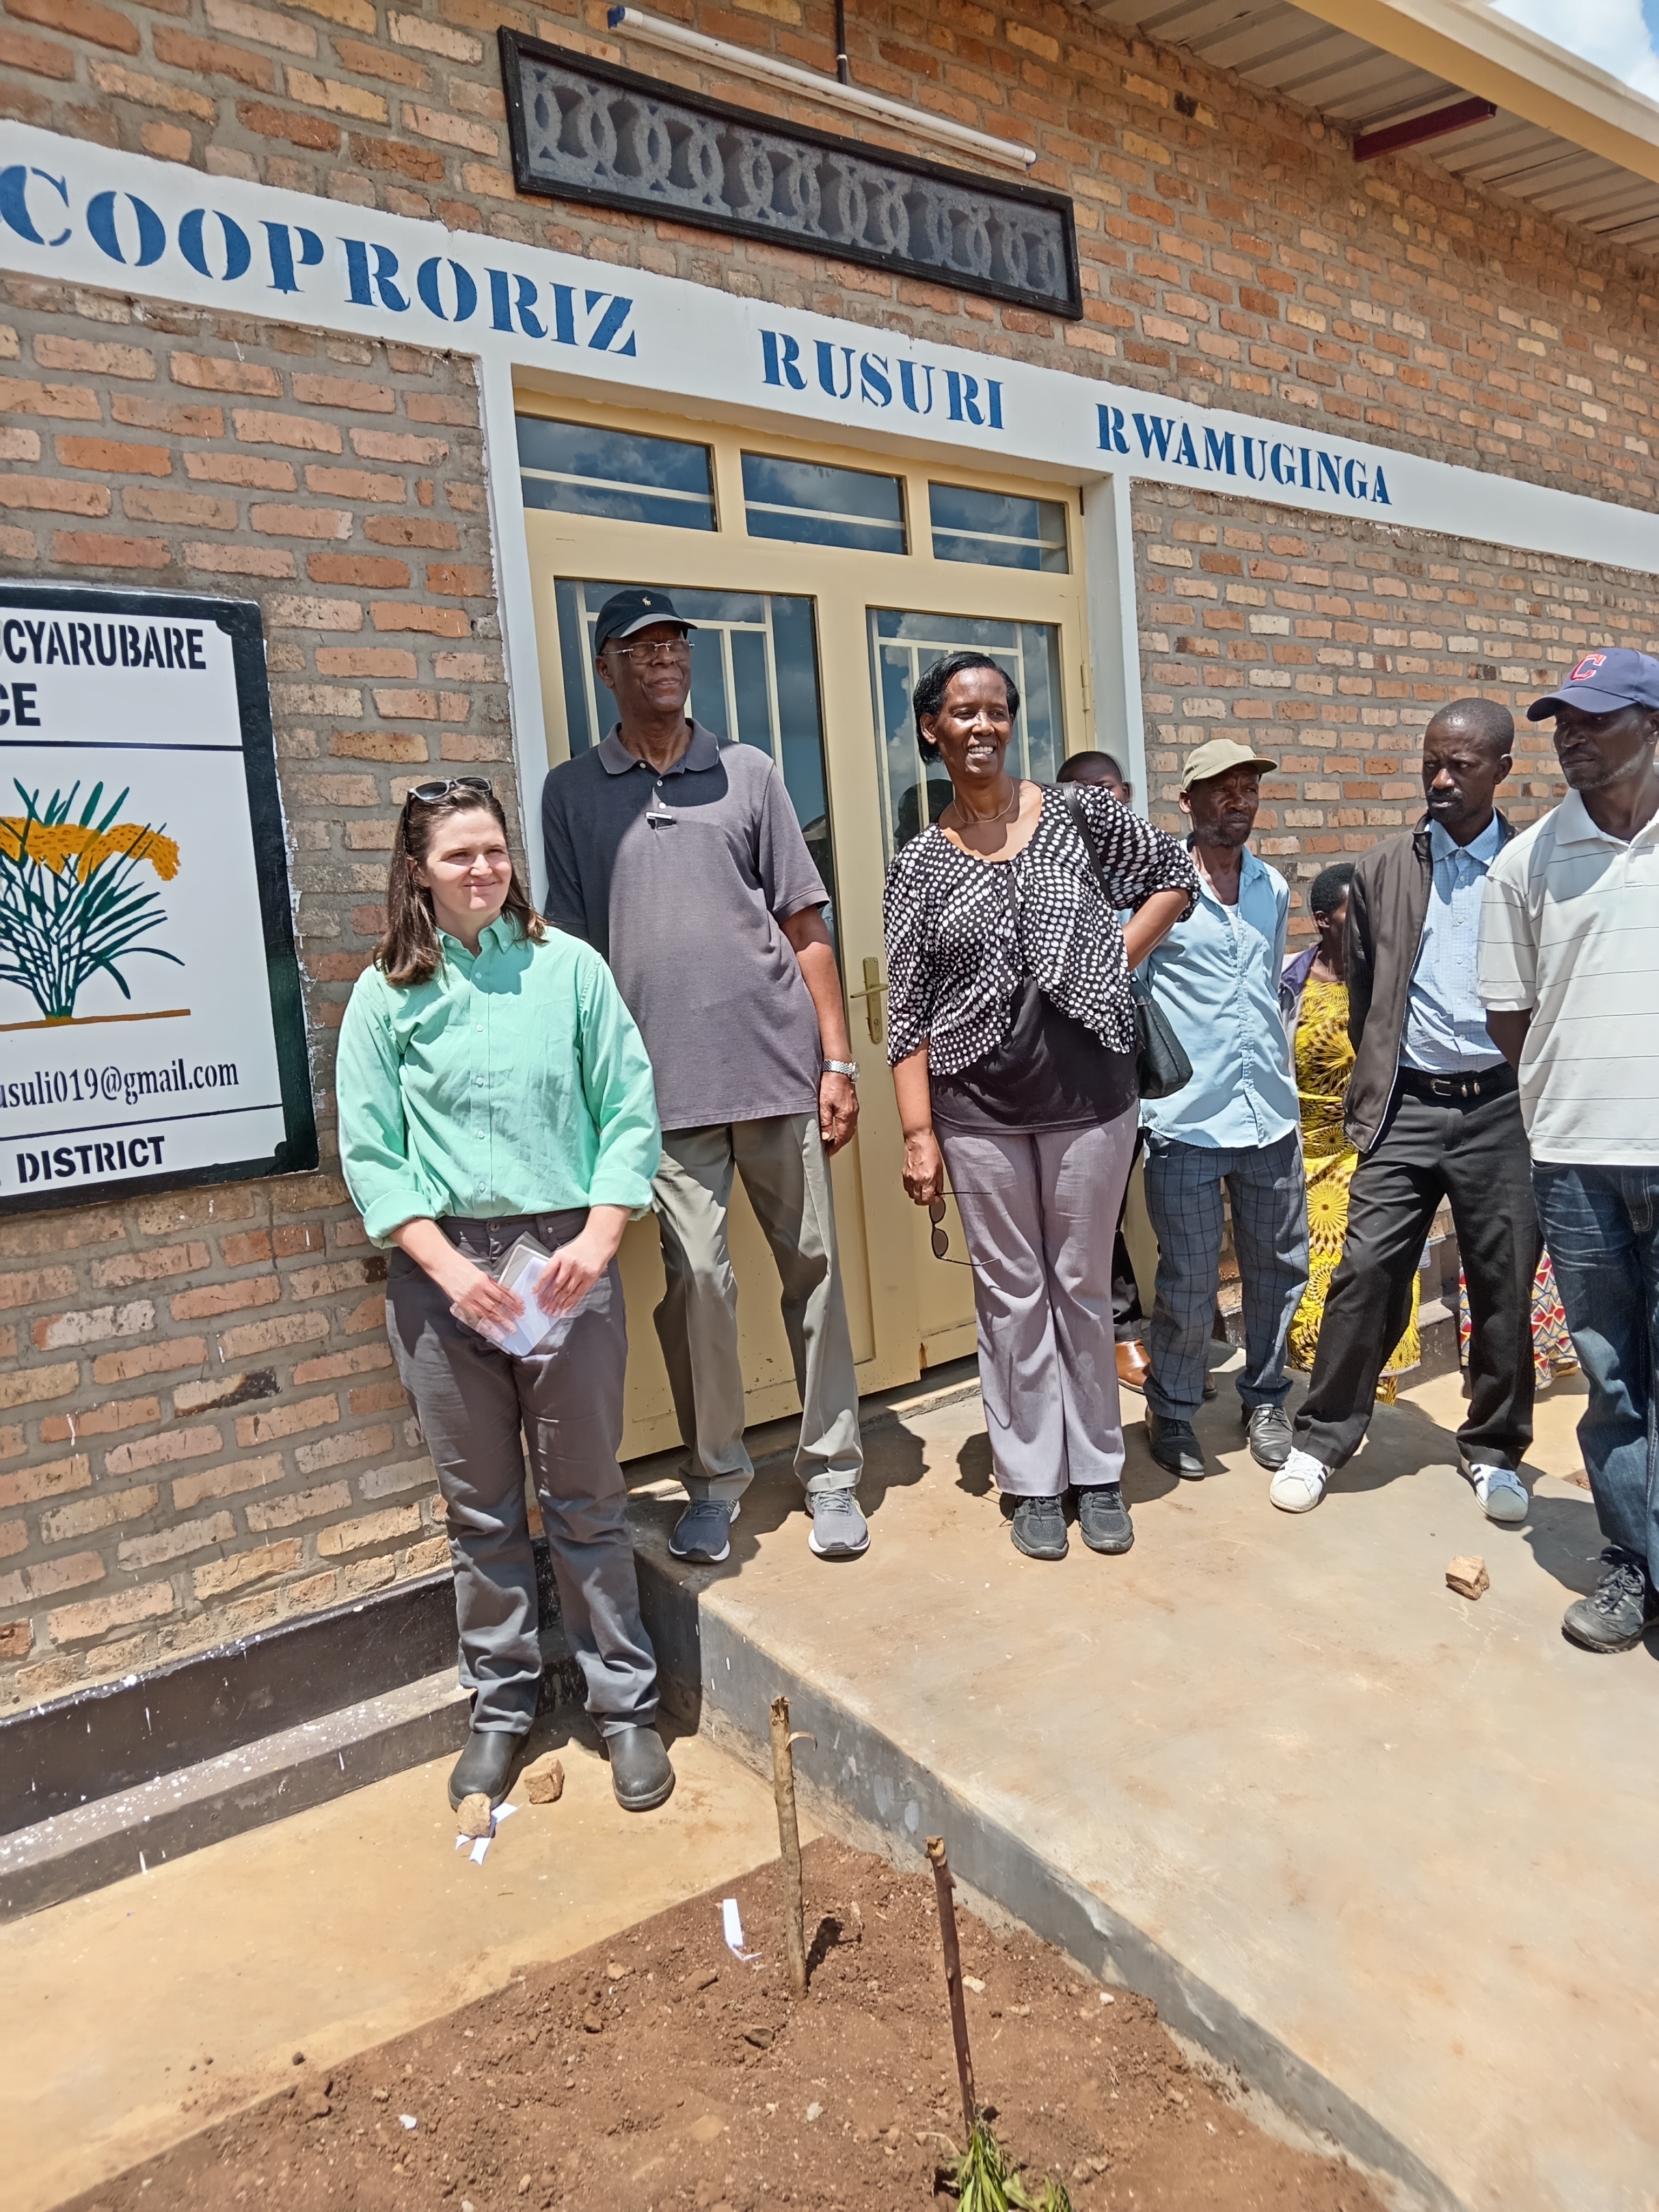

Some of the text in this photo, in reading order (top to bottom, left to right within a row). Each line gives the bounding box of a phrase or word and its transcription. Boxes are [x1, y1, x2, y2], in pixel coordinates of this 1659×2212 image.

[0, 165, 1392, 505] COOPRORIZ RUSURI RWAMUGINGA
[0, 619, 206, 670] CYARUBARE
[1570, 653, 1607, 680] C
[17, 1136, 165, 1183] DISTRICT
